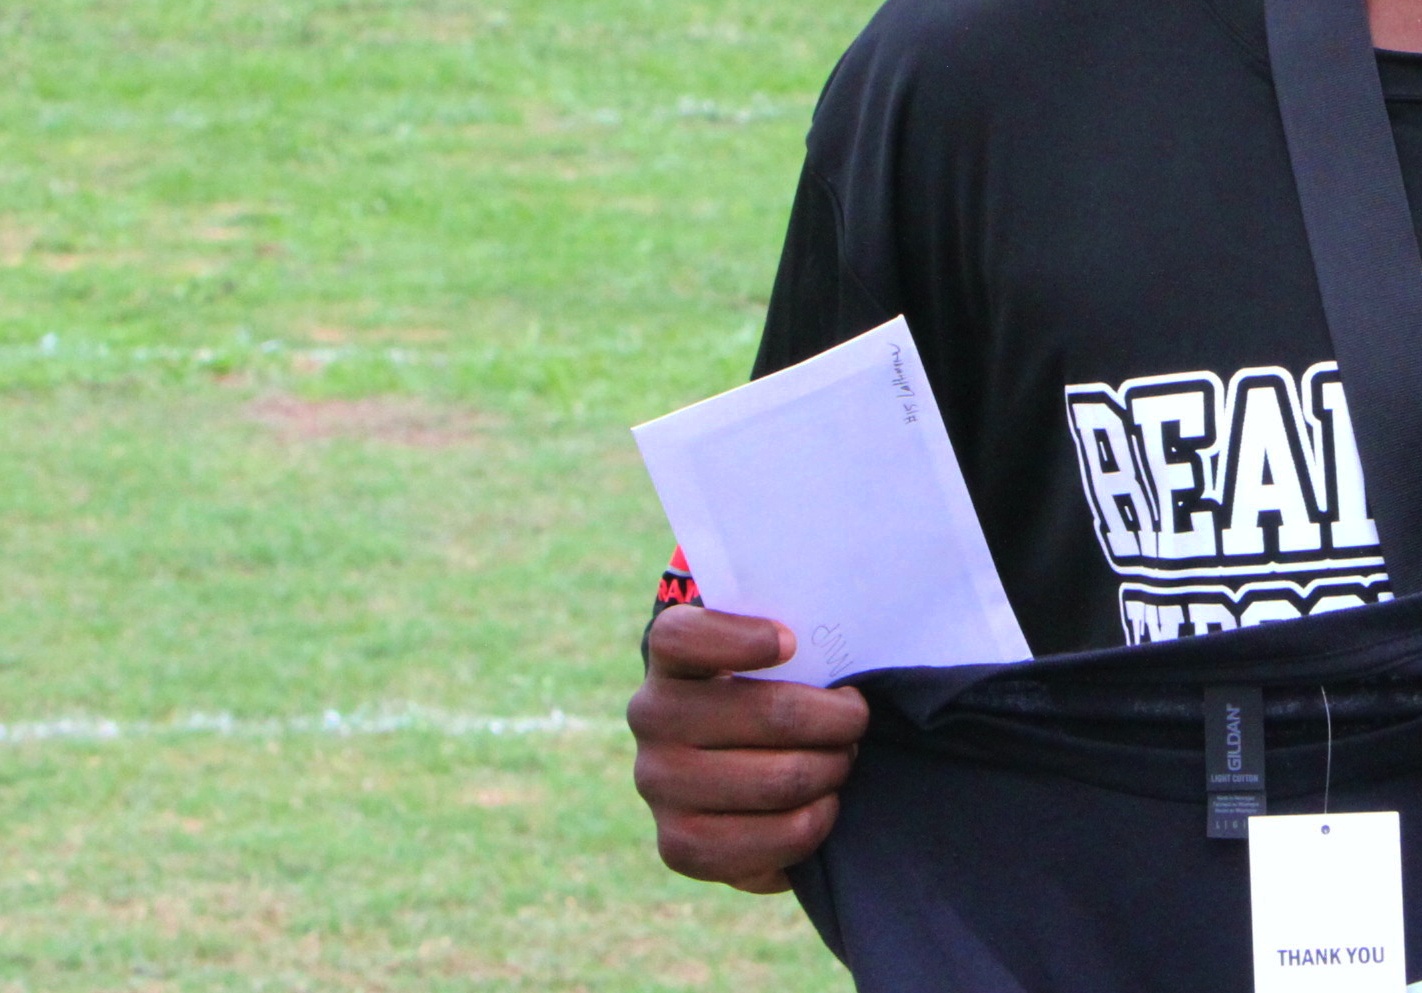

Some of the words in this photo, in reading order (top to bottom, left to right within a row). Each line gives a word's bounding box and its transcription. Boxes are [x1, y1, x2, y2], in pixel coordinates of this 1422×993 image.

[1226, 706, 1242, 772] GILDAN
[1277, 948, 1341, 966] THANK
[1346, 946, 1385, 964] YOU
